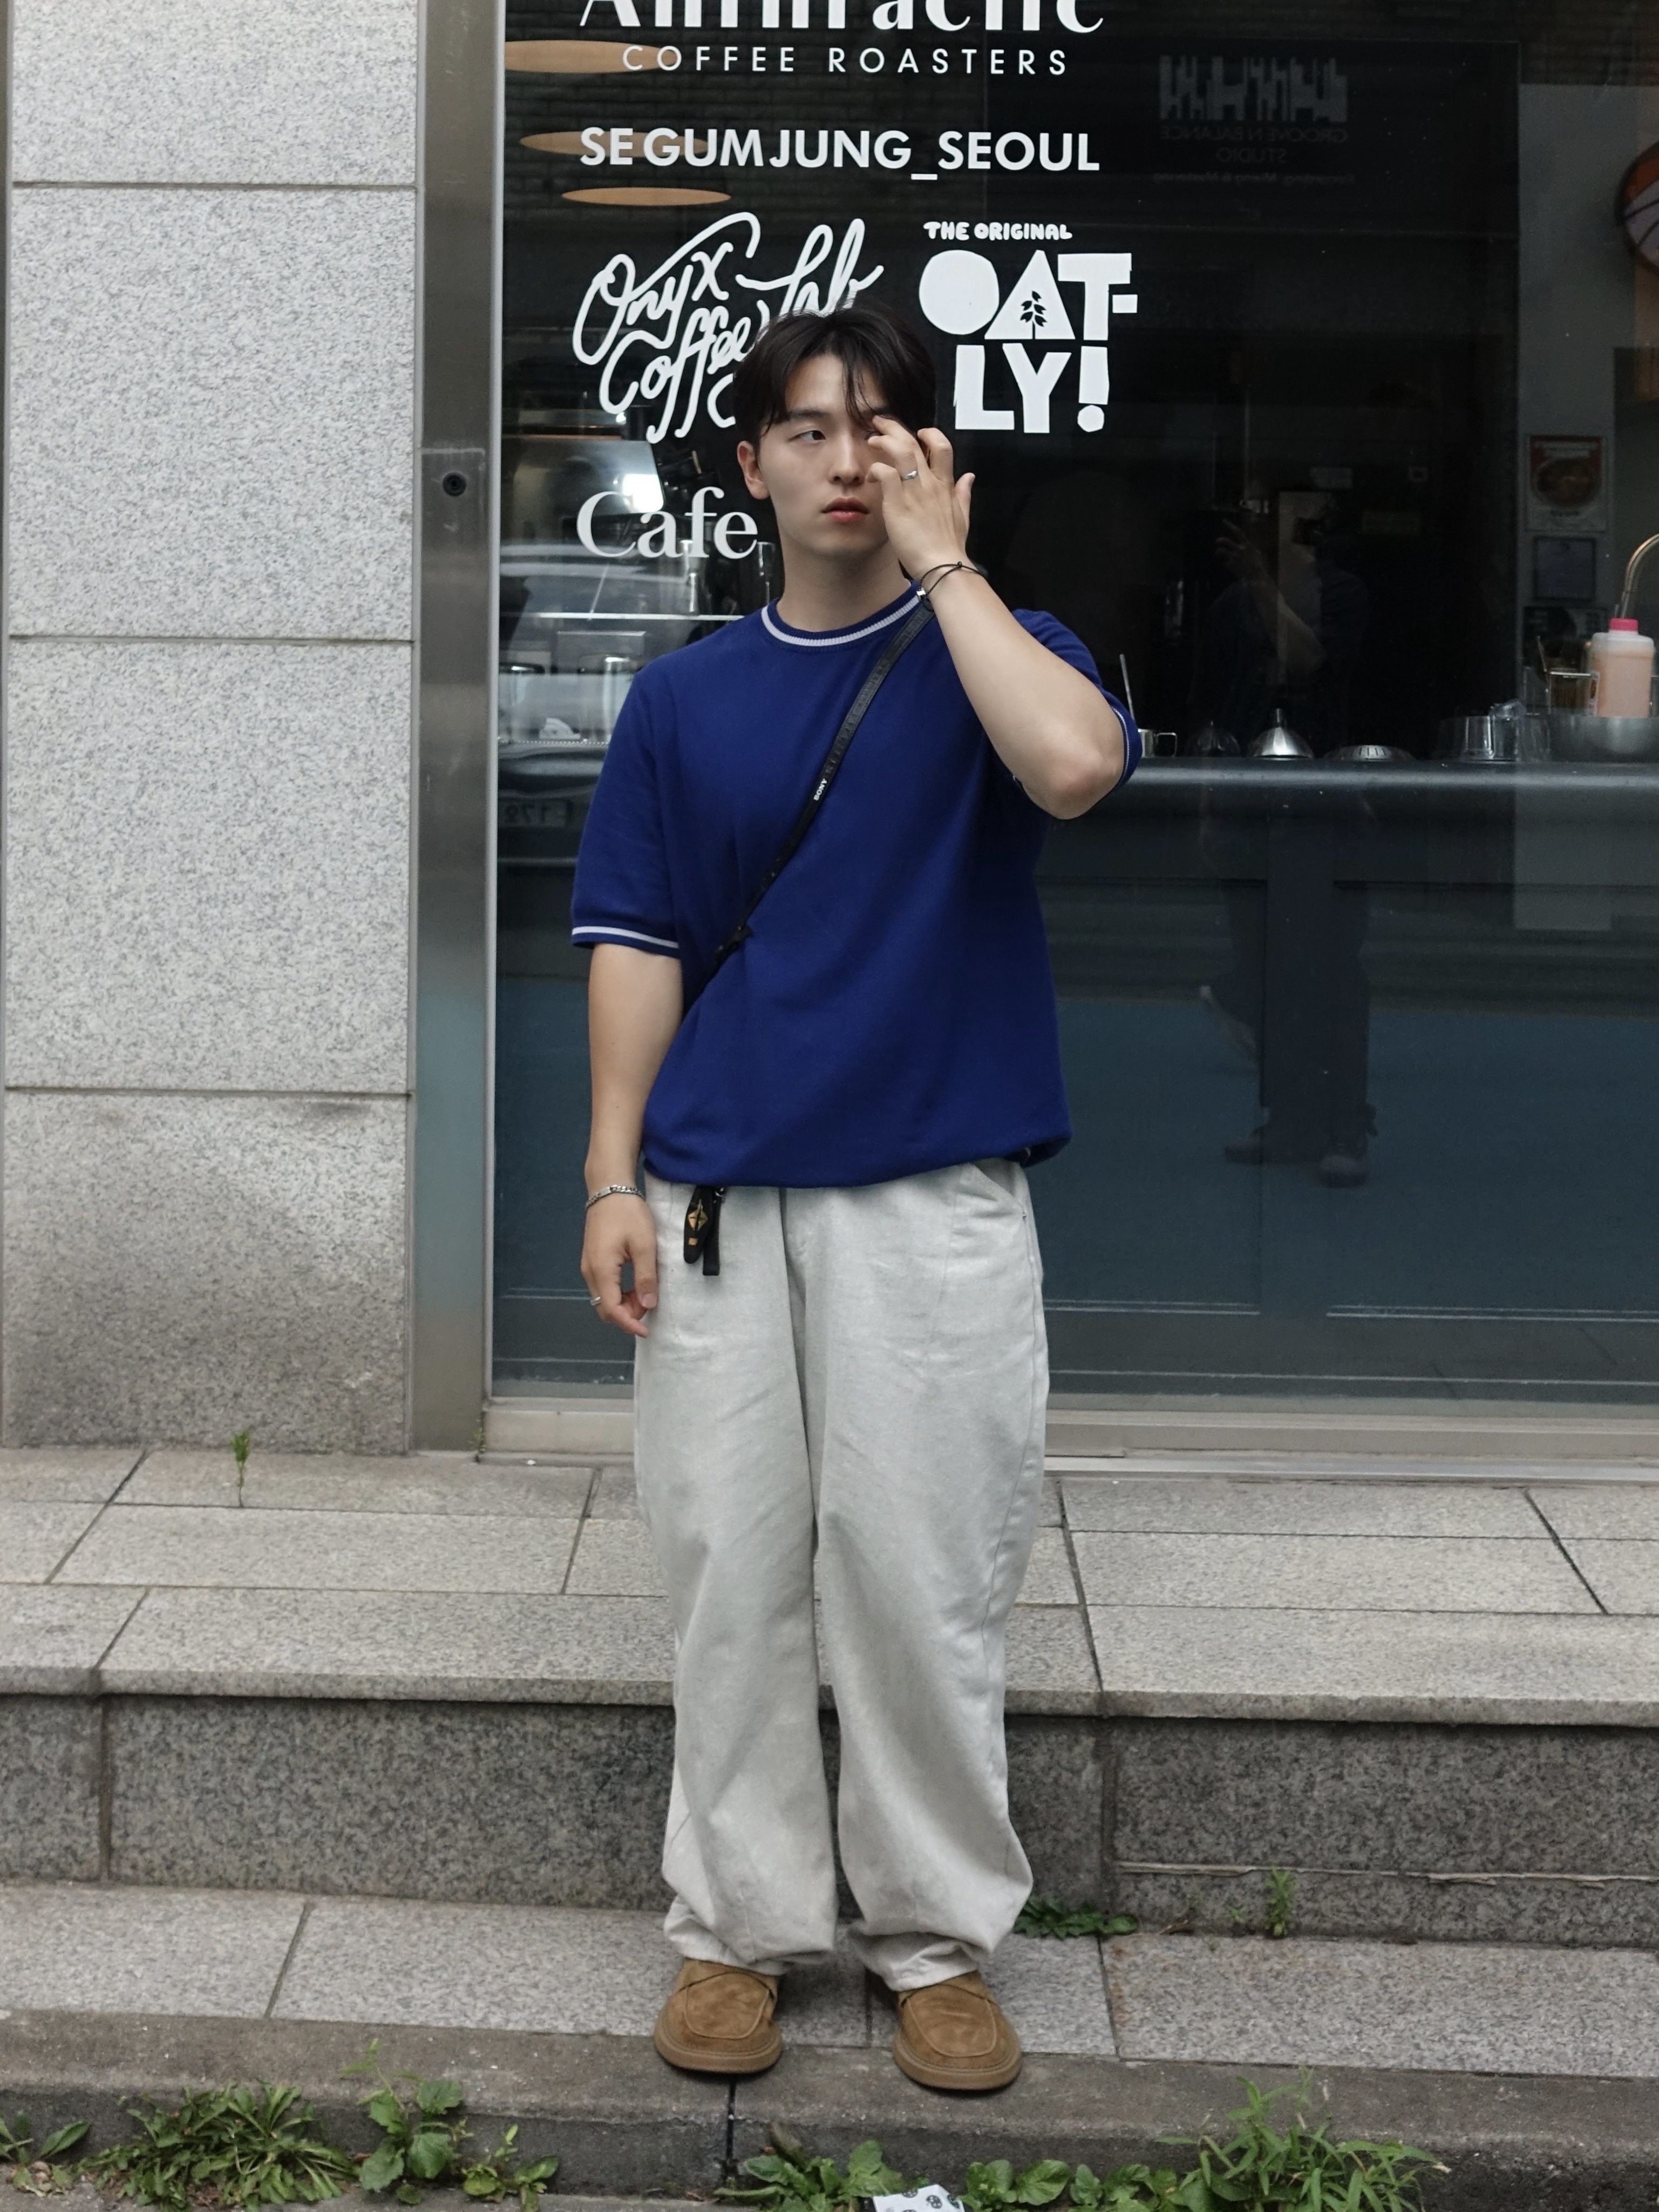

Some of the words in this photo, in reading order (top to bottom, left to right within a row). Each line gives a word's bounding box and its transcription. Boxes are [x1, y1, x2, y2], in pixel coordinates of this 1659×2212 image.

[622, 45, 794, 72] COFFEE
[828, 48, 1066, 75] ROASTERS
[922, 221, 970, 241] THE
[974, 222, 1073, 241] ORIGINAL
[573, 212, 761, 365] Onyx
[953, 342, 1110, 433] LY!
[576, 486, 758, 560] Cafe
[813, 778, 828, 802] SONY
